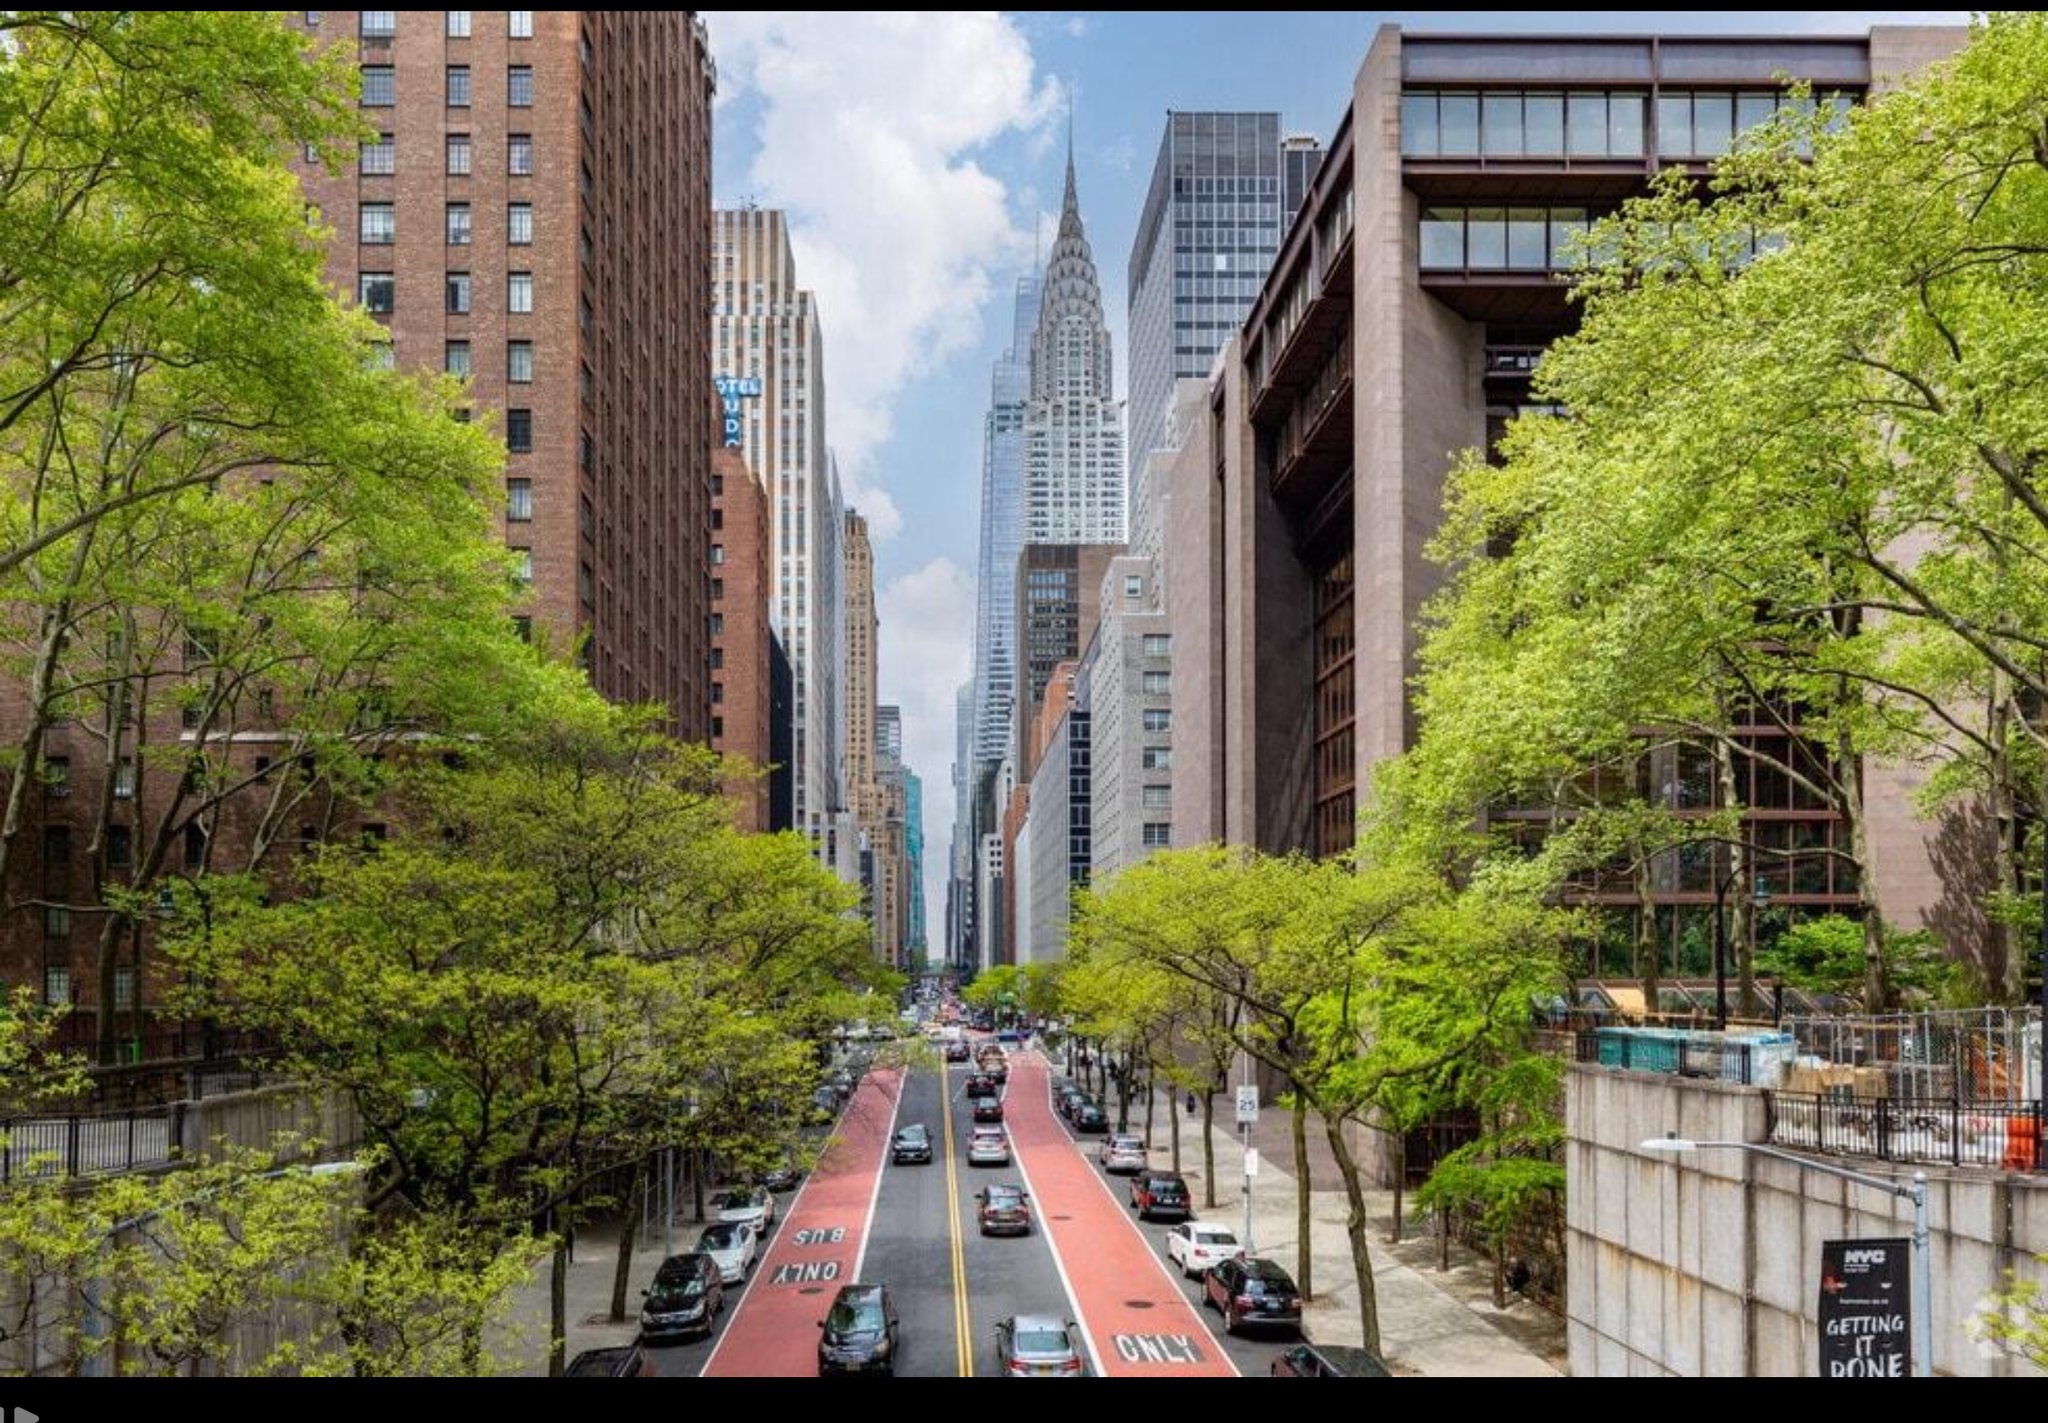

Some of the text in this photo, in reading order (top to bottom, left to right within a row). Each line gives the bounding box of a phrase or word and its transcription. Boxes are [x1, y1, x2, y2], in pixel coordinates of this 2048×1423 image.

[1239, 1099, 1256, 1112] 25
[793, 1226, 846, 1245] BUS
[1845, 1249, 1886, 1264] NYC
[774, 1261, 838, 1284] ONLY
[1827, 1314, 1905, 1335] GETTING
[1116, 1334, 1196, 1364] ONLY
[1855, 1335, 1876, 1357] IT
[1830, 1353, 1904, 1378] DONE
